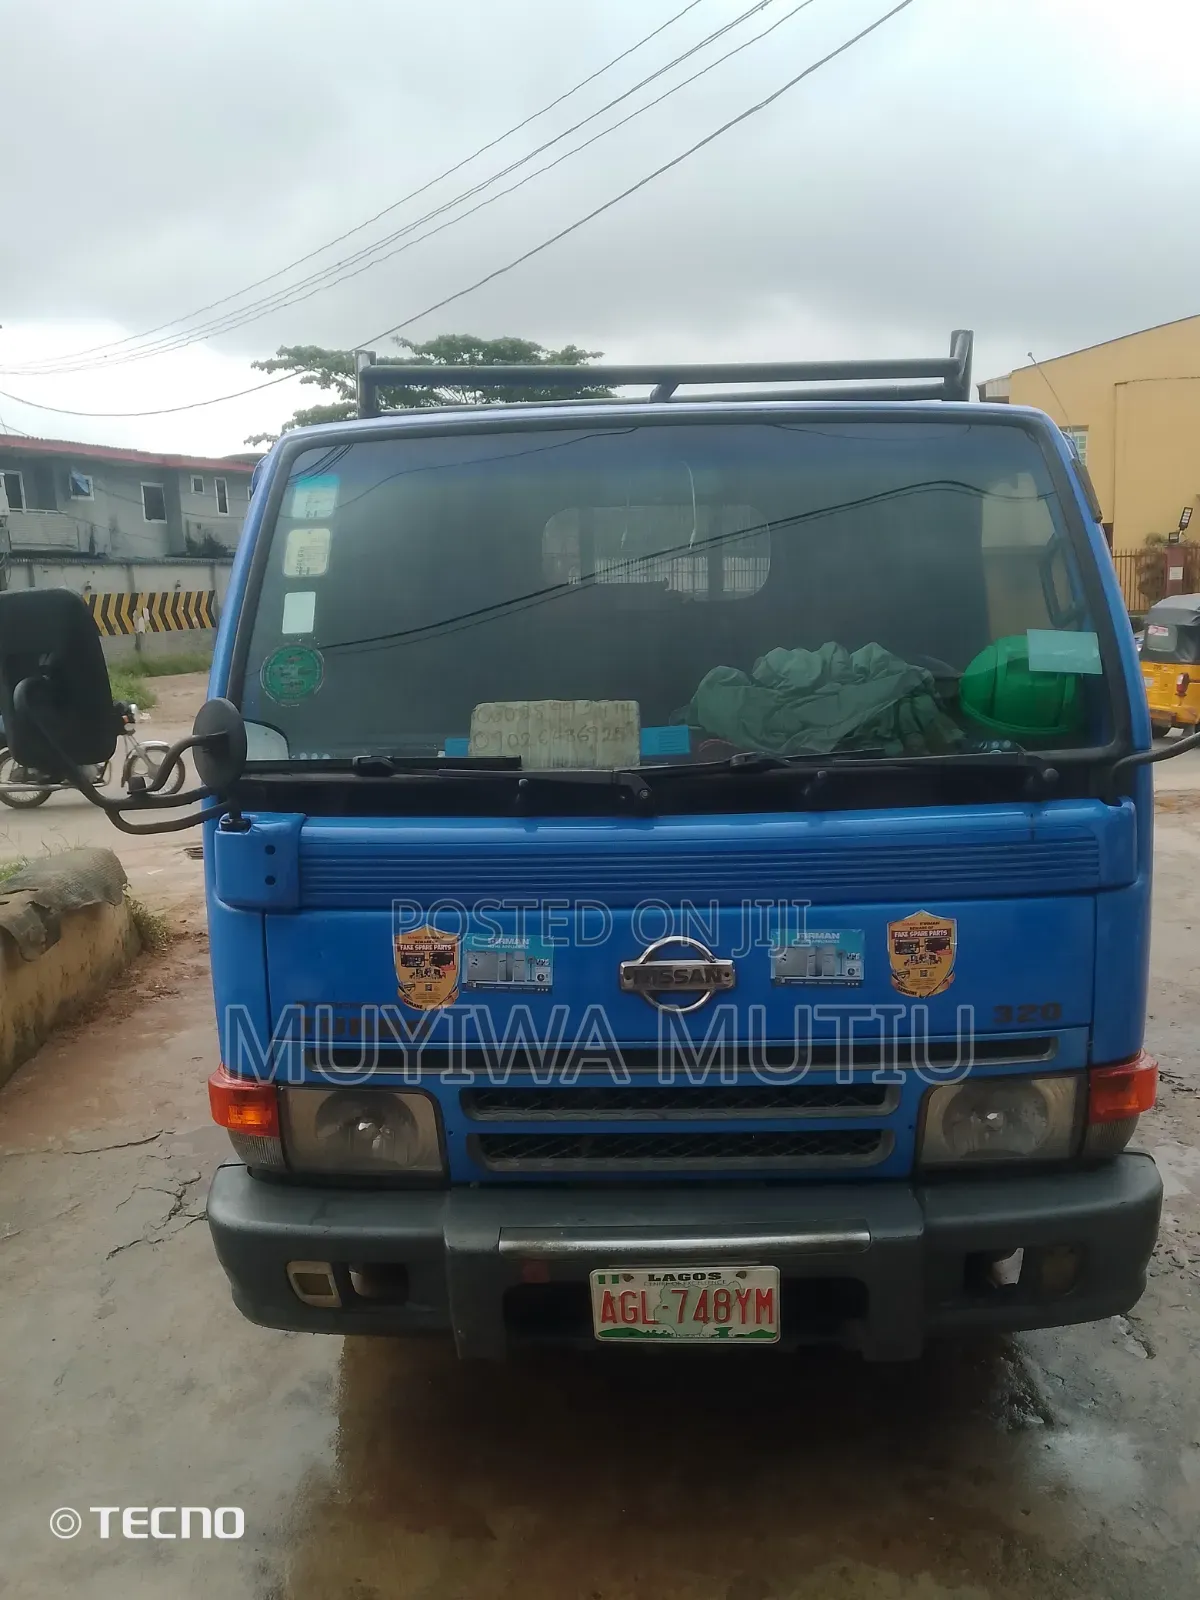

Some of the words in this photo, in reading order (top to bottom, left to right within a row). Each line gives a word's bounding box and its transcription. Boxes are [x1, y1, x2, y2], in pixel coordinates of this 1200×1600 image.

[634, 967, 722, 985] NISSAN
[993, 1002, 1062, 1024] 320
[648, 1272, 722, 1281] LAGOS
[600, 1288, 774, 1325] AGL-748YM
